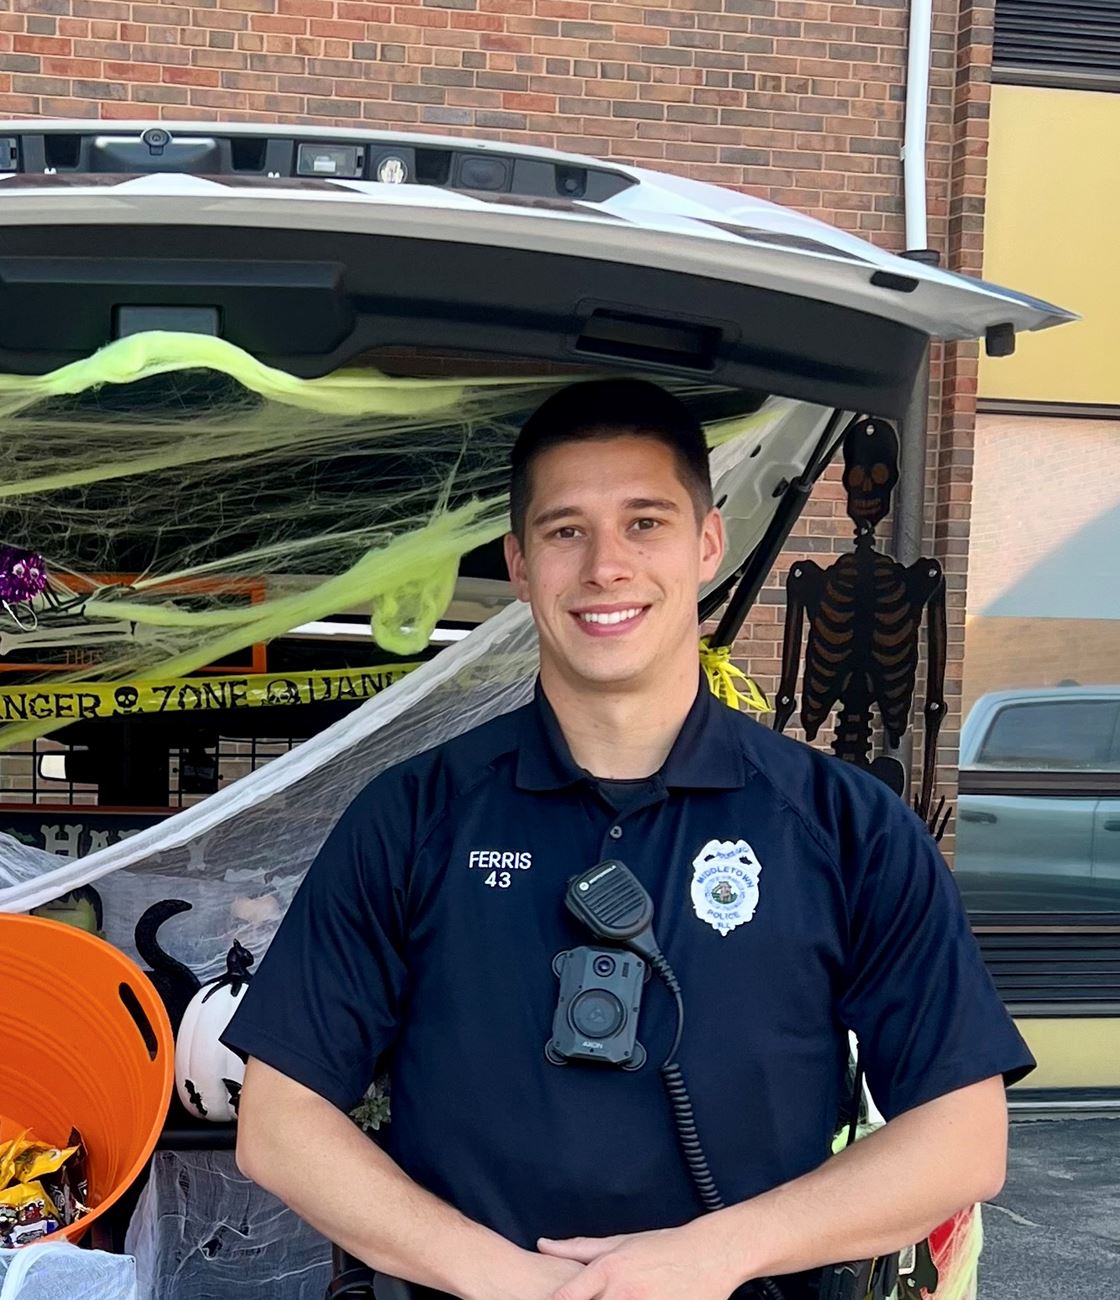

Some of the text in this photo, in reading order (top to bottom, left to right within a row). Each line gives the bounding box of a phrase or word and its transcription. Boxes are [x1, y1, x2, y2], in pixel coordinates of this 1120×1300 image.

[151, 679, 250, 713] ZONE
[468, 850, 532, 870] FERRIS
[484, 870, 512, 888] 43
[696, 866, 755, 889] MIDDLETOWN
[707, 908, 740, 920] POLICE
